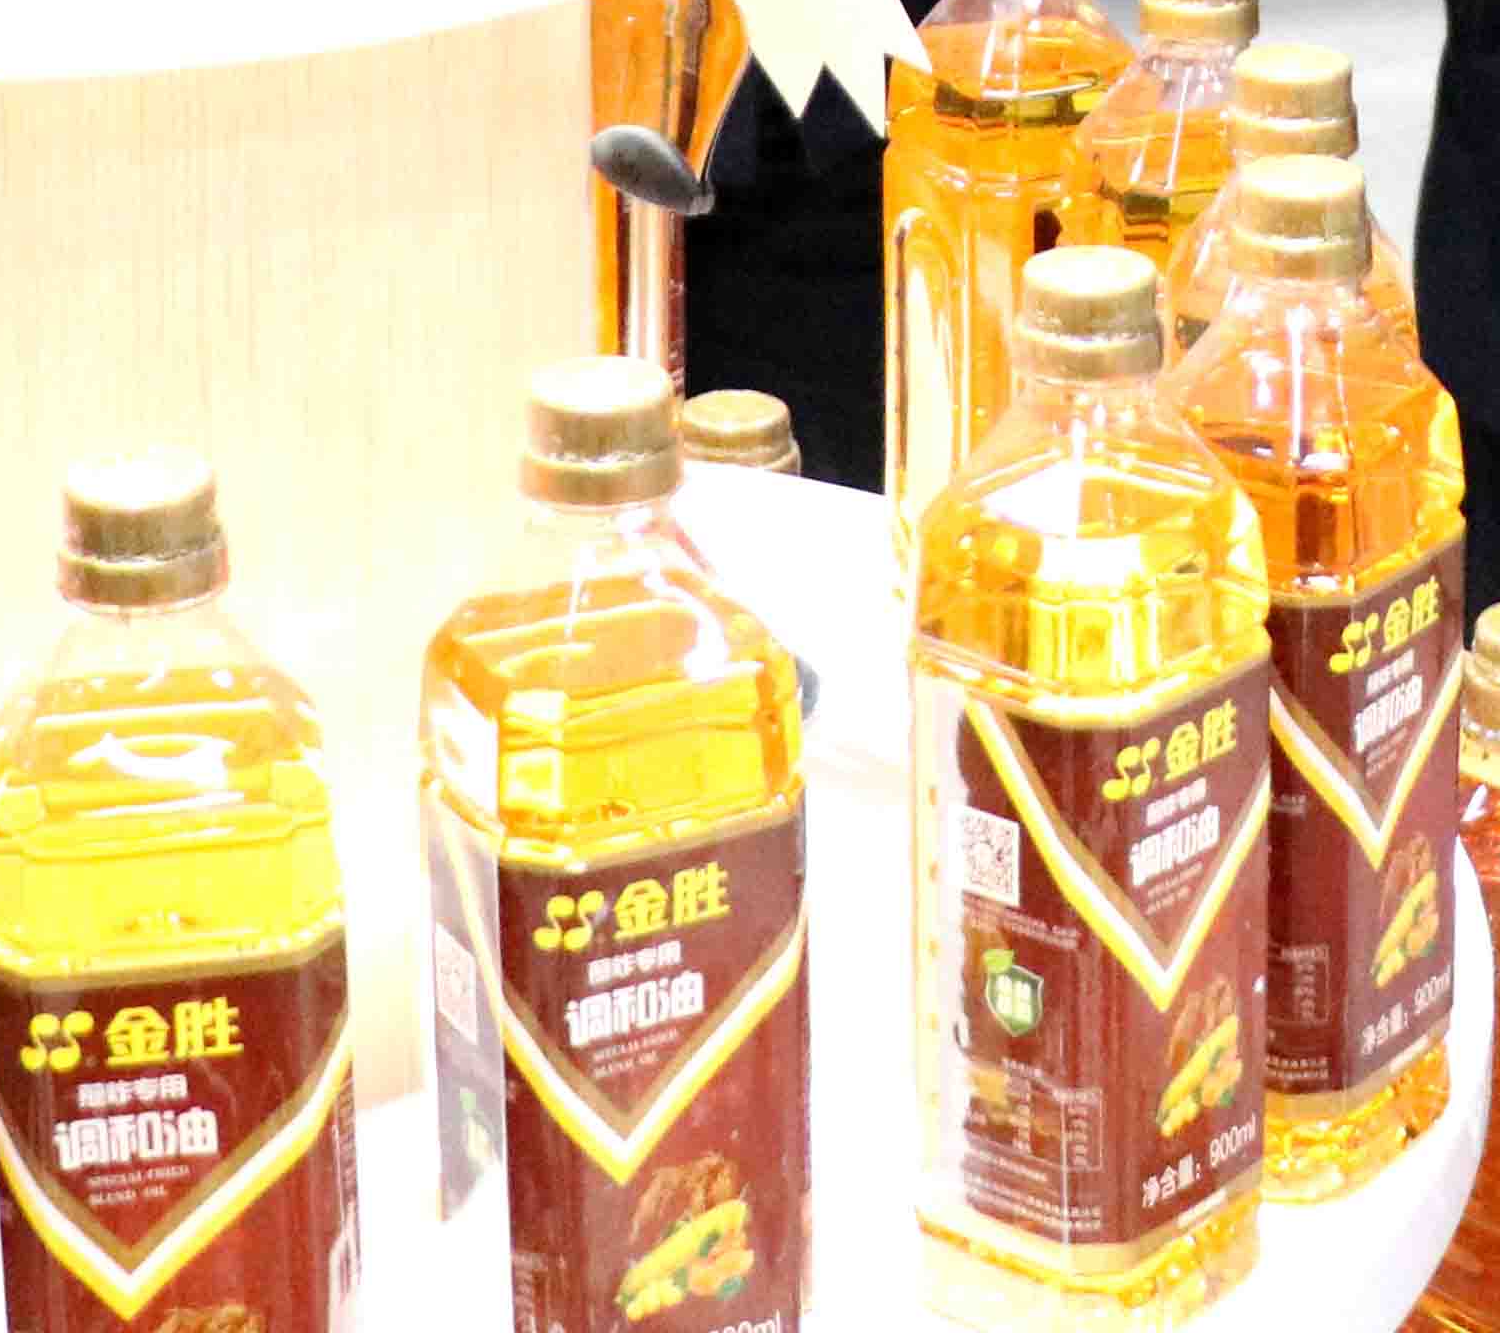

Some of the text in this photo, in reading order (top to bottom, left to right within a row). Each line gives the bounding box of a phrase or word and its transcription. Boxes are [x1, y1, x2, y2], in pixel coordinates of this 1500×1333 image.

[1381, 575, 1440, 653] 金胜
[1164, 699, 1237, 782] 金胜
[1355, 675, 1423, 754] 调和油
[1130, 804, 1220, 887] 调和油
[614, 861, 731, 941] 金胜
[106, 997, 245, 1067] 金胜
[565, 969, 704, 1047] 调和油
[53, 1106, 219, 1171] 调和油
[1208, 1113, 1257, 1167] 900ml
